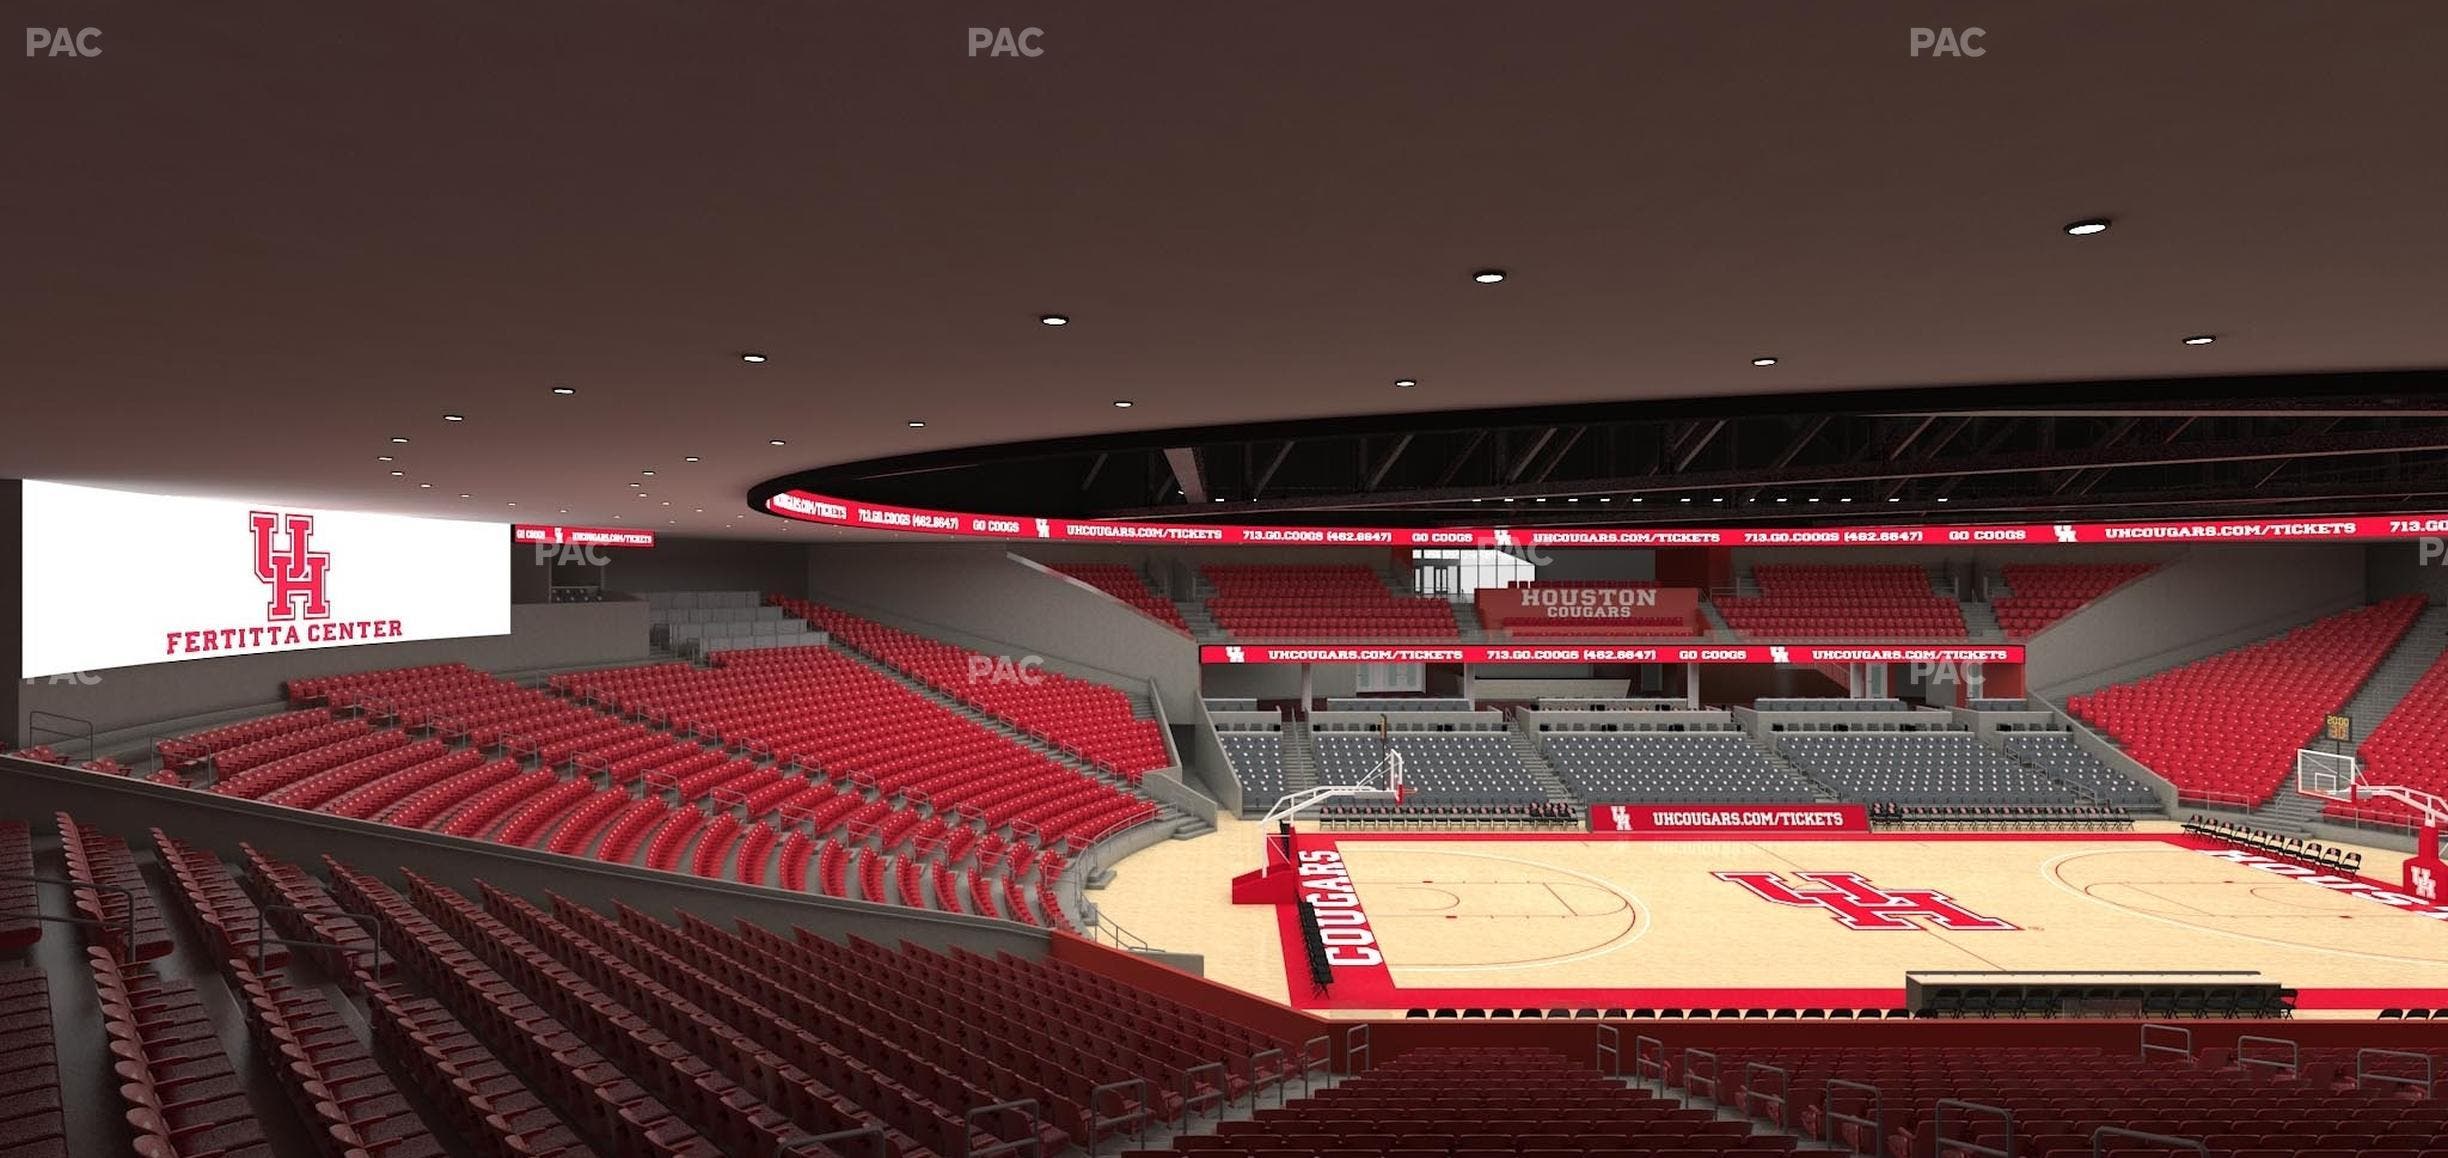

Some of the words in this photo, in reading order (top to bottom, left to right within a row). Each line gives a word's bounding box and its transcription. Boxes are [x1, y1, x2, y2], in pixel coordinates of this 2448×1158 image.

[1067, 524, 1222, 539] UHCOUGARS.COM/TICKETS
[1412, 533, 1429, 543] GO
[1431, 533, 1473, 543] COOGS
[1533, 533, 1721, 543] UHCOUGARS.COM/TICKETS
[1949, 530, 1970, 541] GO
[1973, 530, 2026, 541] COOGS
[2105, 522, 2356, 539] UHCOUGARS.COM/TICKETS
[1521, 589, 1657, 606] HOUSTON
[1547, 606, 1631, 618] COUGARS
[166, 625, 300, 655] FERTITTA
[307, 620, 403, 642] CENTER
[1268, 650, 1463, 660] UHCOUGARS.COM/TICKETS
[1679, 650, 1698, 660] GO
[1701, 650, 1747, 660] COOGS
[1812, 650, 2007, 660] UHCOUGARS.COM/TICKETS
[1653, 812, 1843, 827] UHCOUGARS.COM/TICKETS
[1298, 849, 1384, 966] COUGARS
